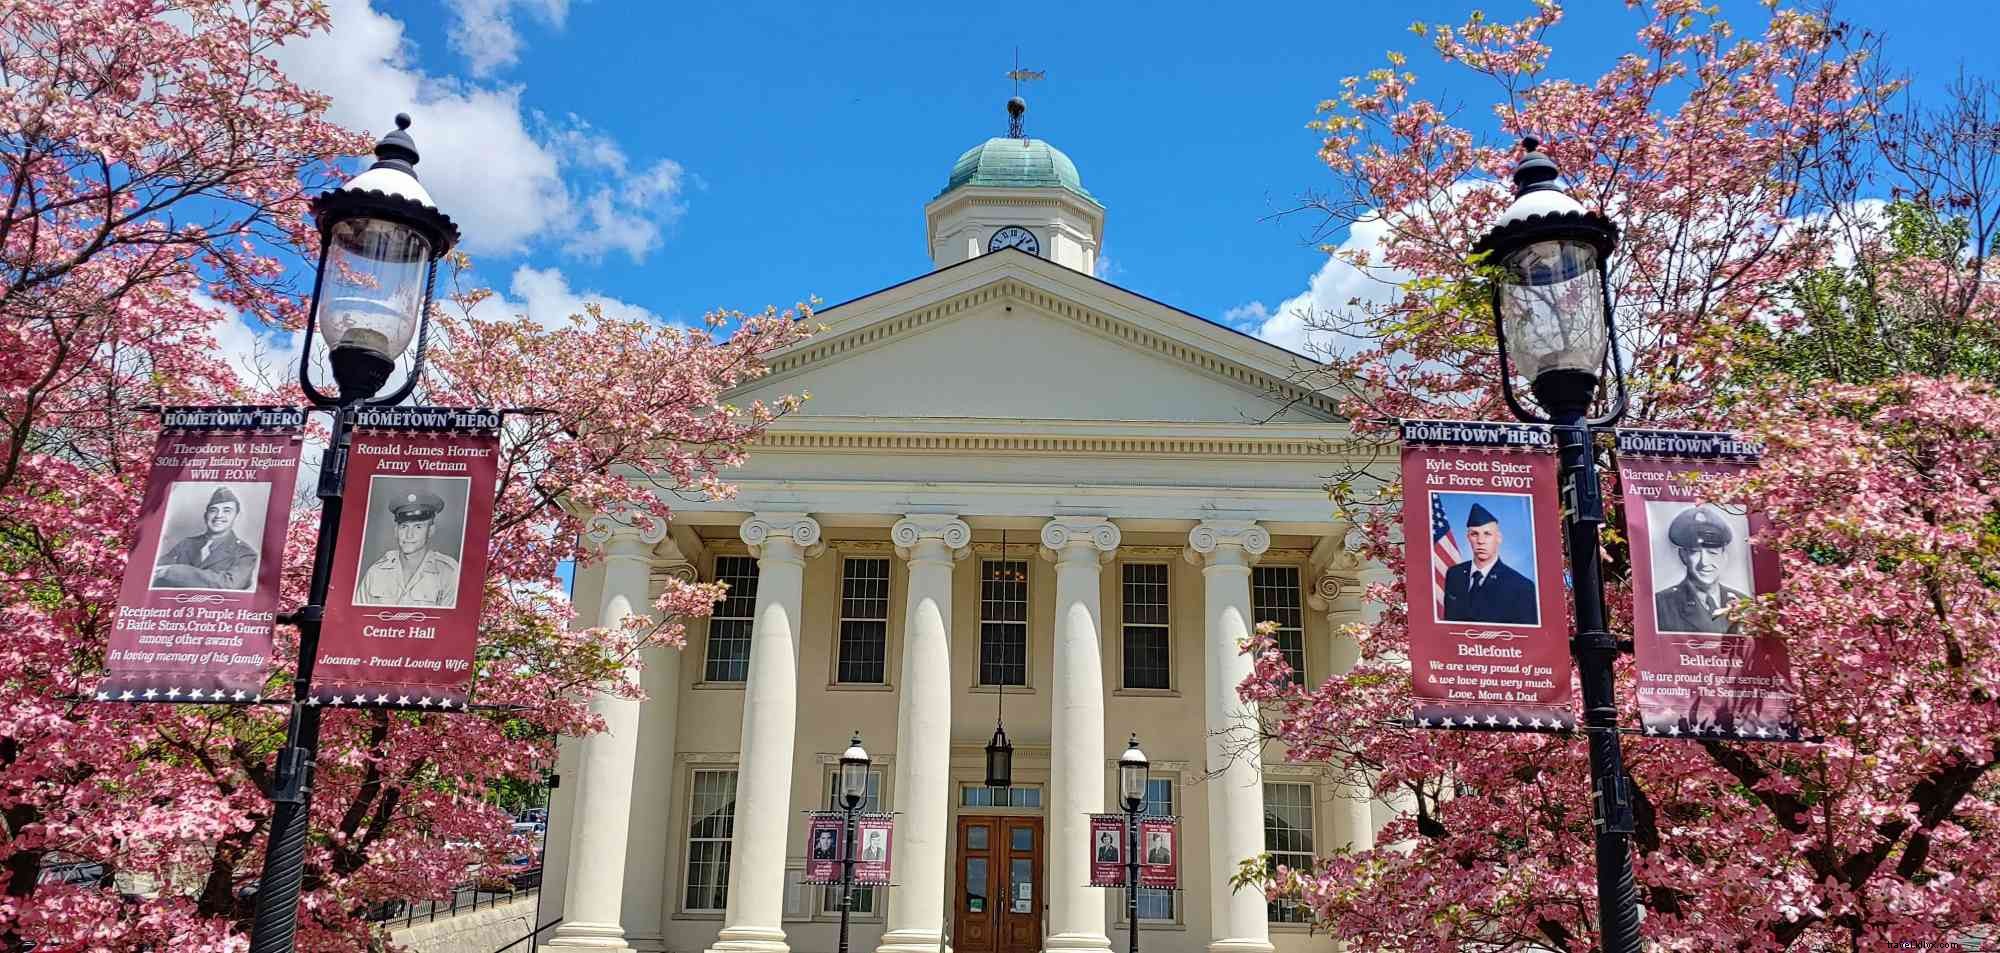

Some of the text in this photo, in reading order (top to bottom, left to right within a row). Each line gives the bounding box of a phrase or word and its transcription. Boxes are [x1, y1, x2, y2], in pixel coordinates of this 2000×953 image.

[165, 412, 303, 426] HOMETOWN HERO
[358, 412, 499, 427] HOMETOWN HERO
[1405, 426, 1551, 444] HOMETOWN HERO
[174, 443, 229, 454] Theodore
[250, 444, 283, 454] Ishler
[357, 443, 491, 457] Ronald James Horner
[1620, 437, 1713, 453] HOMETOWN
[180, 458, 208, 470] Army
[209, 457, 248, 469] Infantry
[251, 457, 295, 470] Regiment
[376, 459, 467, 472] Army Vietnam
[1426, 459, 1533, 475] Kyle Scott Spicer
[191, 470, 218, 480] WWII
[1426, 474, 1534, 488] Air Force GWOT
[1623, 468, 1665, 481] Clarence
[1629, 486, 1662, 498] Army
[120, 606, 273, 622] Recipient of 3 Purple Hearts
[116, 620, 125, 630] 5
[126, 620, 155, 630] Battle
[218, 622, 232, 632] De
[235, 623, 272, 635] Guerre
[363, 625, 436, 639] Centre Hall
[139, 634, 243, 647] among other awards
[110, 649, 264, 666] In loving memory of his family
[1458, 644, 1523, 658] Bellefonte
[318, 655, 361, 666] Joanne
[370, 657, 401, 668] Proud
[404, 657, 441, 670] Loving
[445, 660, 468, 671] Wife
[1429, 660, 1552, 676] We are very proud of you
[1680, 654, 1744, 668] Bellefonte
[1428, 674, 1437, 684] &
[1457, 676, 1478, 685] love
[1480, 678, 1498, 688] you
[1501, 679, 1523, 689] very
[1525, 678, 1555, 689] much.
[1641, 670, 1655, 681] We
[1656, 673, 1673, 682] are
[1674, 673, 1702, 686] proud
[1703, 673, 1714, 687] of
[1478, 690, 1502, 701] Mom
[1505, 691, 1514, 701] &
[1516, 690, 1537, 702] Dad
[1639, 687, 1656, 695] our
[1657, 687, 1691, 697] country
[1698, 686, 1716, 697] The
